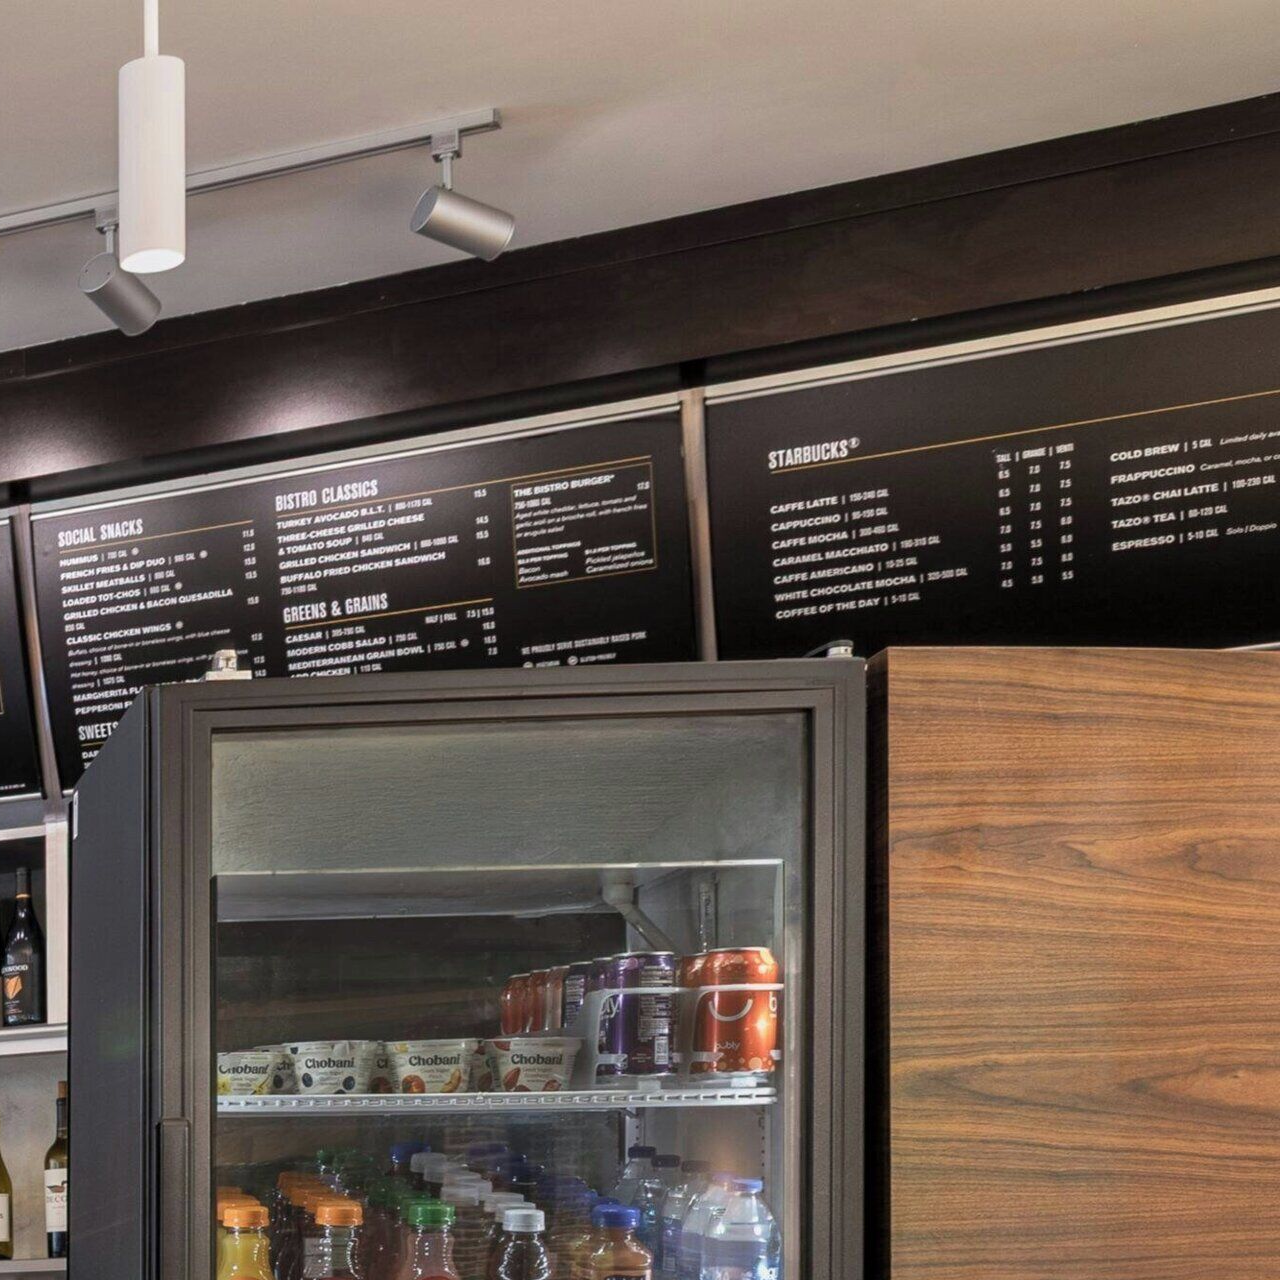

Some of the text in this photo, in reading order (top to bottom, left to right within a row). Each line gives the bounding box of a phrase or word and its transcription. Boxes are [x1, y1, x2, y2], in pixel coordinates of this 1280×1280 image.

[1110, 449, 1142, 461] COLD
[1144, 444, 1180, 457] BREW
[1199, 440, 1212, 449] CAL
[1111, 465, 1195, 484] FRAPPUCCINO
[276, 490, 317, 512] BISTRO
[322, 480, 378, 505] CLASSICS
[514, 488, 532, 498] THE
[534, 482, 569, 494] BISTRO
[1153, 489, 1182, 500] CHAI
[1184, 484, 1218, 496] LATTE
[770, 497, 837, 514] CAFFE LATTE
[277, 507, 384, 530] TURKEY AVOCADO B.L.T.
[772, 515, 840, 532] CAPPUCCINO
[58, 519, 143, 547] SOCIAL SNACKS
[278, 514, 424, 544] THREE-CHEESE GRILLED CHEESE
[278, 538, 352, 555] & TOMATO SOUP
[772, 532, 848, 549] CAFFE MOCHA
[1112, 535, 1175, 550] ESPRESSO
[60, 554, 98, 568] HUMMUS
[279, 543, 410, 570] GRILLED CHICKEN SANDWICH
[773, 544, 888, 567] CARAMEL MACCHIATO
[60, 558, 165, 580] FRENCH FRIES & DIP DUO
[281, 552, 445, 584] BUFFALO FRIED CHICKEN SANDWICH
[774, 564, 874, 584] CAFFE AMERICANO
[62, 574, 145, 594] SKILLET MEATBALLS
[775, 576, 916, 602] WHITE CHOCOLATE MOCHA
[63, 589, 140, 607] LOADED TOT-CHOS
[64, 589, 232, 620] GRILLED CHICKEN & BACON QUESADILLA
[284, 594, 388, 624] GREENS & GRAINS
[776, 599, 880, 619] COFFEE OF THE DAY
[66, 624, 171, 646] CLASSIC CHICKEN WINGS
[286, 632, 322, 644] CAESAR
[287, 638, 386, 658] MODERN COBB SALAD
[289, 646, 424, 672] MEDITERRANEAN GRAIN BOWL
[74, 688, 128, 702] MARGHERITA
[75, 702, 126, 716] PEPPERONI
[305, 1057, 354, 1069] Chobani
[409, 1054, 460, 1066] Chobani
[511, 1054, 562, 1065] Chobani
